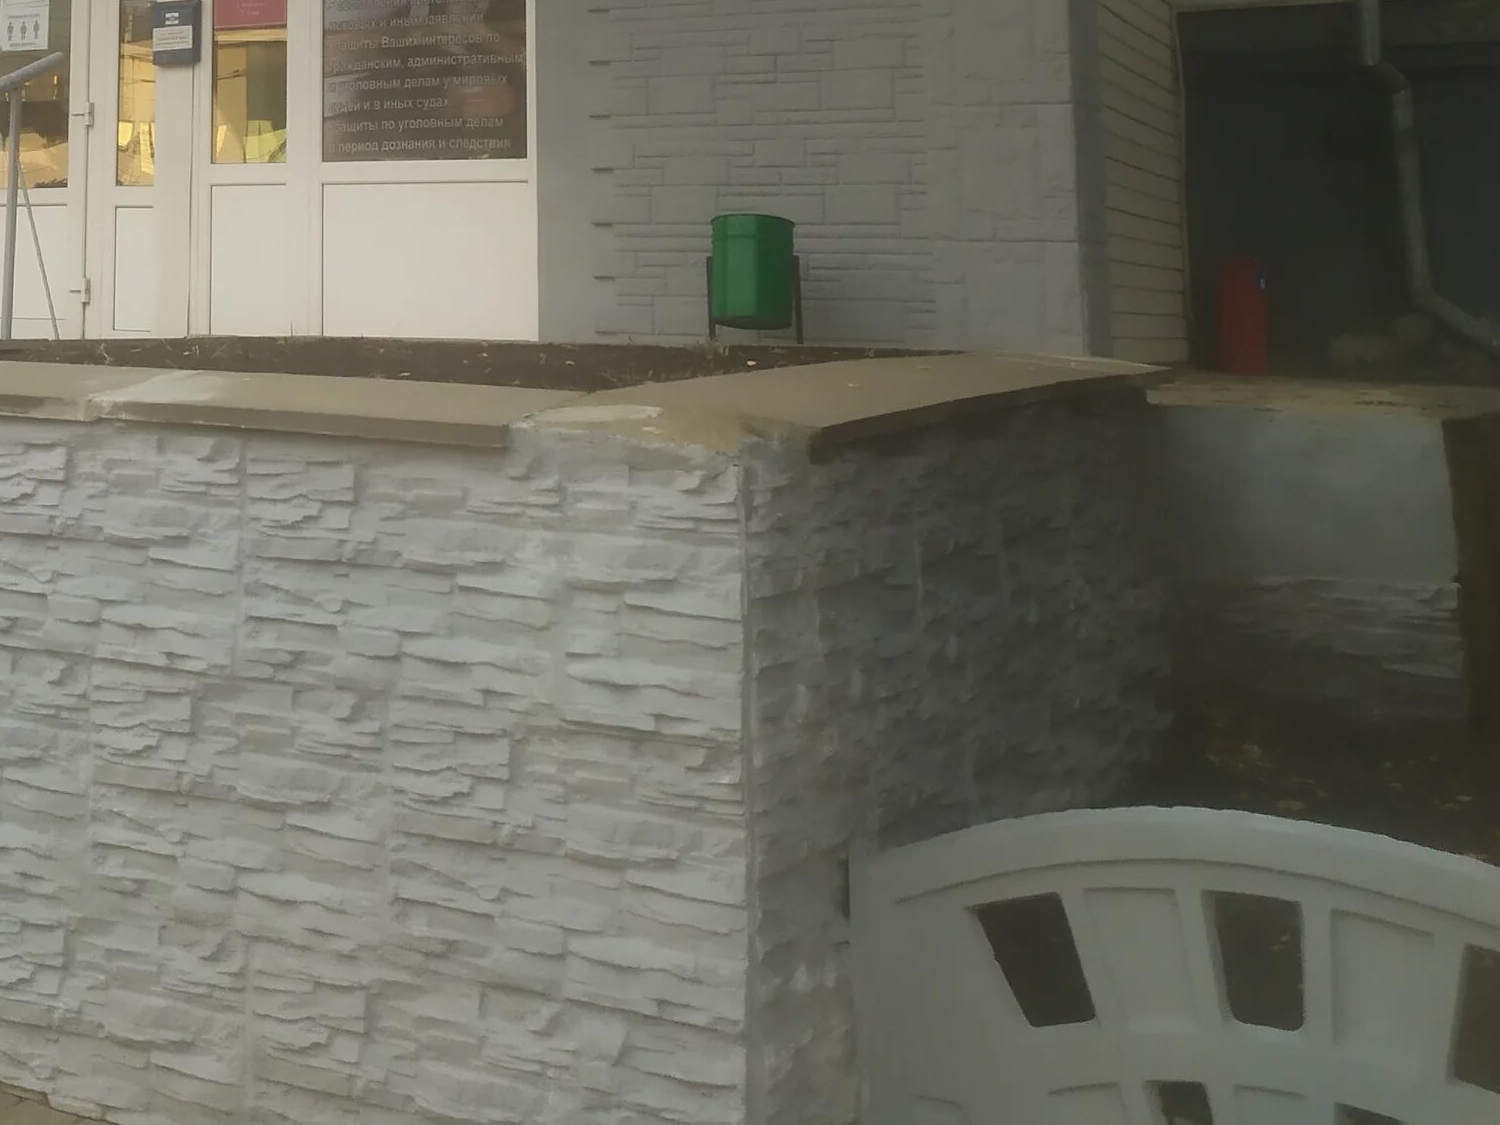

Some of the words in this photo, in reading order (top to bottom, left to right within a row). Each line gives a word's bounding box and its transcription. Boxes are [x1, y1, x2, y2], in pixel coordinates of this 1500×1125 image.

[381, 35, 418, 49] Ваших
[404, 76, 440, 89] делам
[383, 99, 414, 110] иных
[416, 97, 449, 111] судах
[380, 119, 395, 131] по
[398, 117, 463, 133] уголовным
[465, 115, 504, 130] делам
[337, 141, 379, 155] период
[381, 138, 436, 153] дознания
[448, 136, 511, 152] следствия
